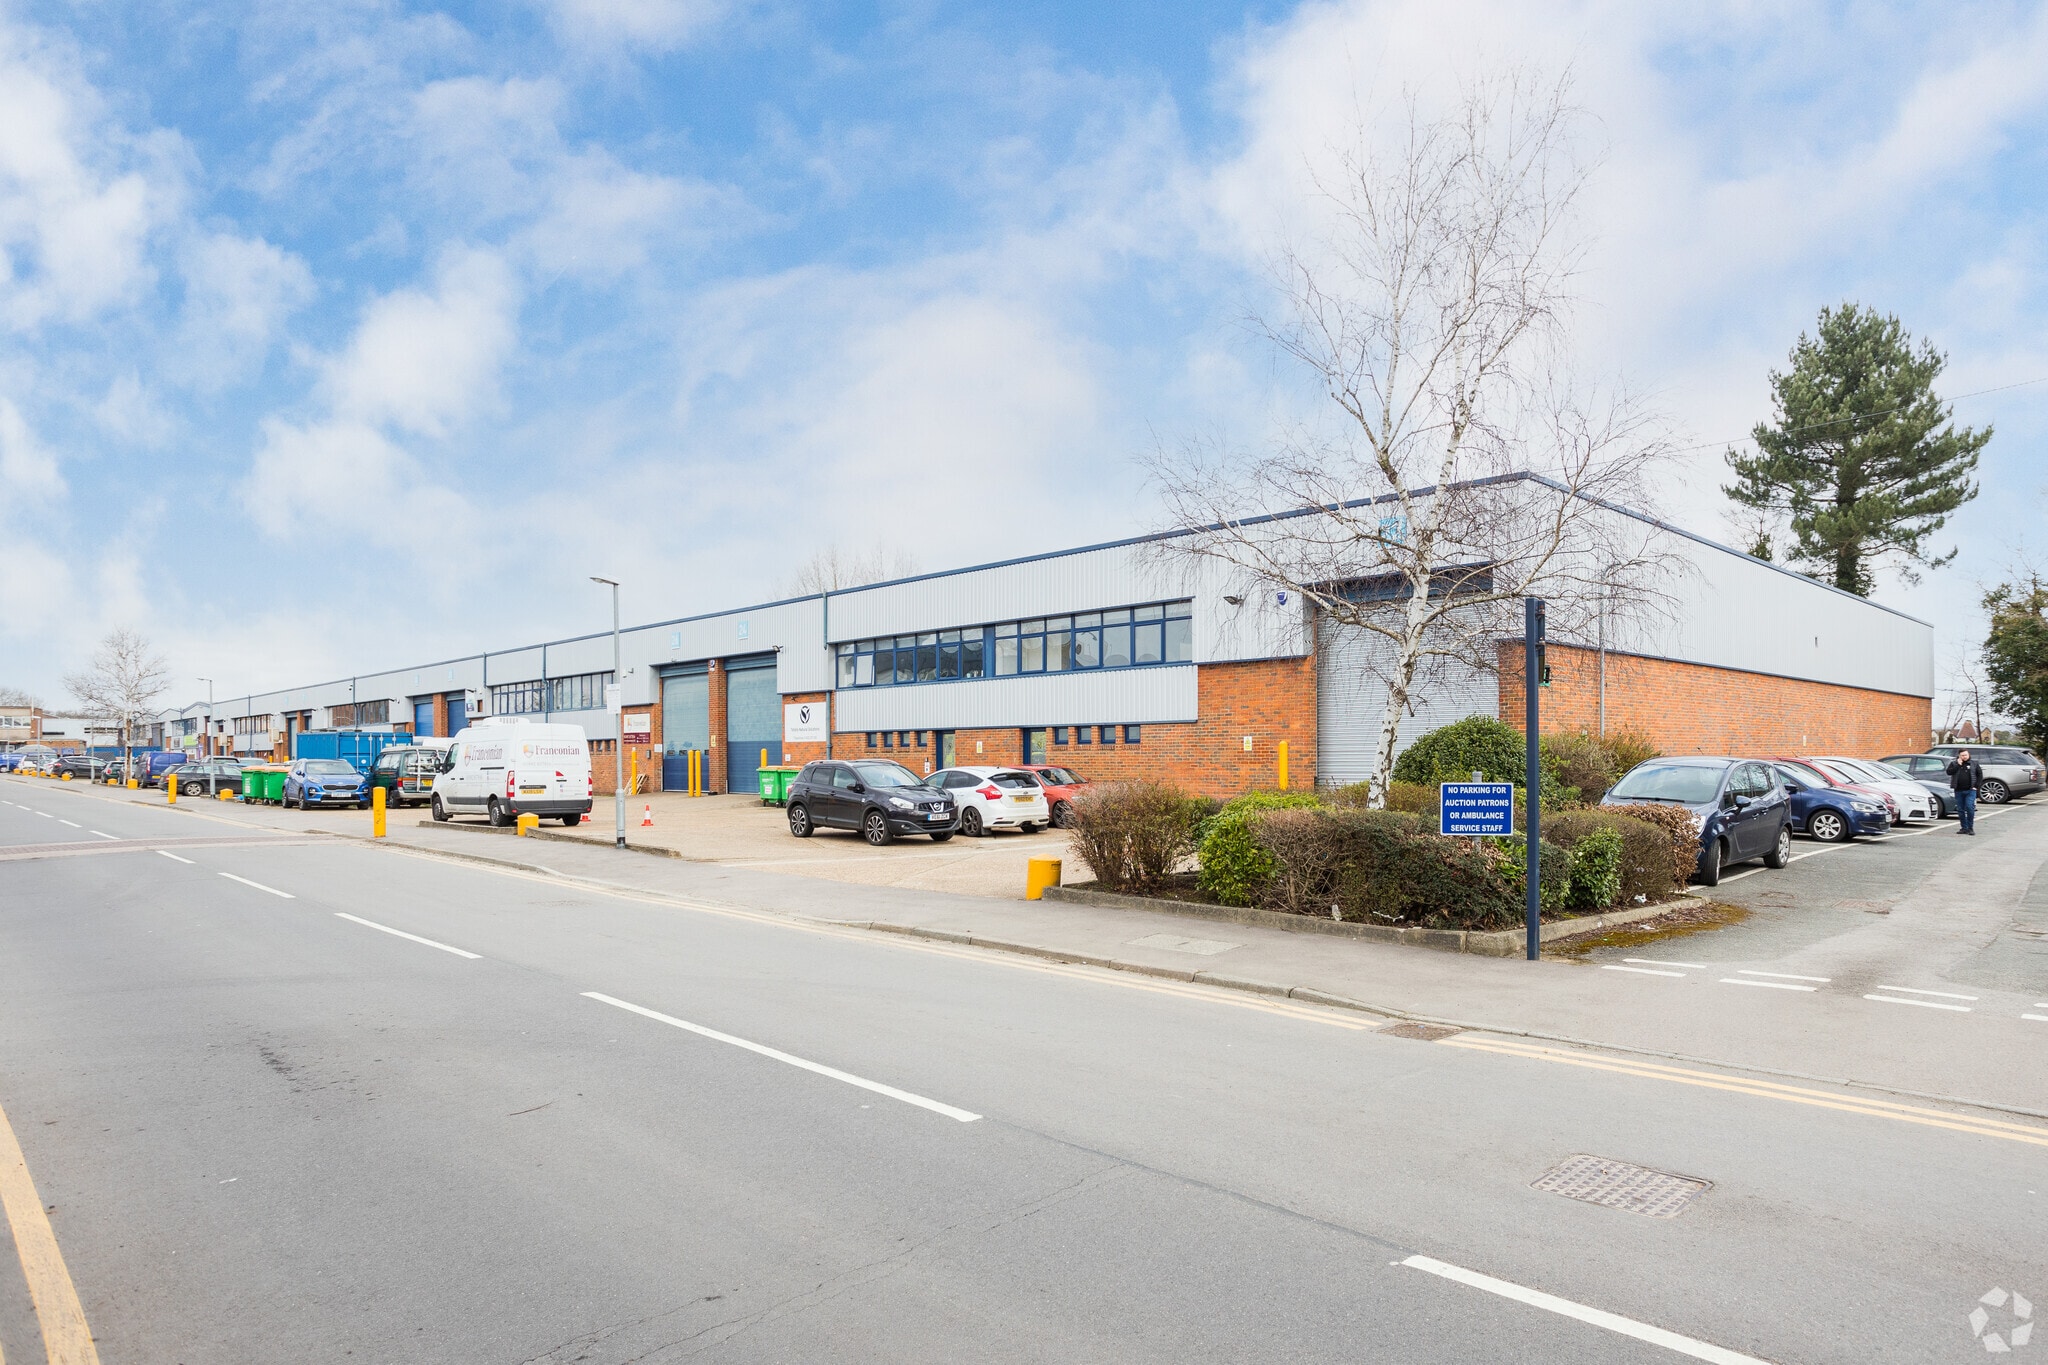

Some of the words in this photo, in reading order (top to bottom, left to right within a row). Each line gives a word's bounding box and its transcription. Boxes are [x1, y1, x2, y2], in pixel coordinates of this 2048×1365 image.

[535, 745, 580, 755] Franconian
[1447, 786, 1459, 794] NO
[1459, 786, 1491, 794] PARKING
[1492, 786, 1507, 794] FOR
[1444, 799, 1476, 807] AUCTION
[1477, 799, 1509, 807] PATRONS
[1449, 811, 1460, 819] OR
[1461, 811, 1505, 819] AMBULANCE
[1450, 824, 1480, 832] SERVICE
[1481, 824, 1503, 832] STAFF
